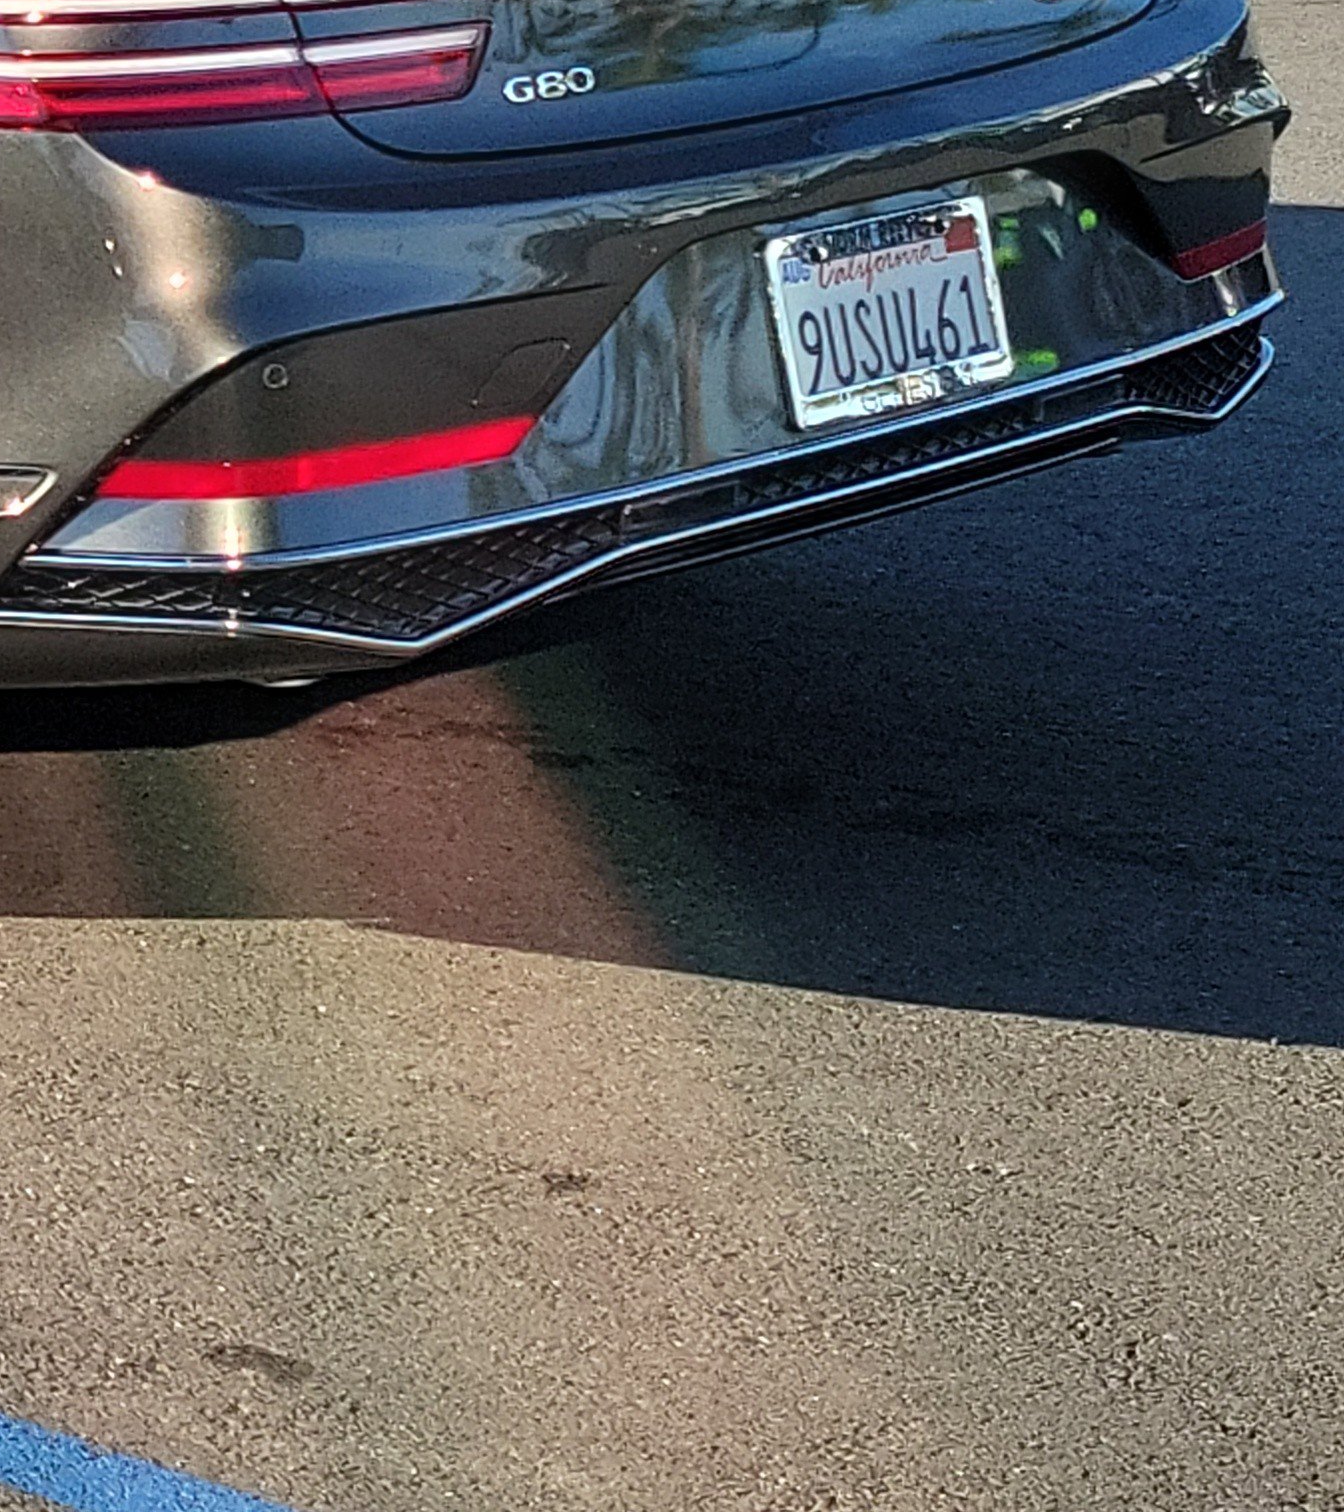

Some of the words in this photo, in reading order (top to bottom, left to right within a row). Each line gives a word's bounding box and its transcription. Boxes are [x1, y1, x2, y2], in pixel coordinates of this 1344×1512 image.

[502, 67, 595, 104] G80
[818, 243, 948, 293] California
[798, 275, 989, 395] 9USU461
